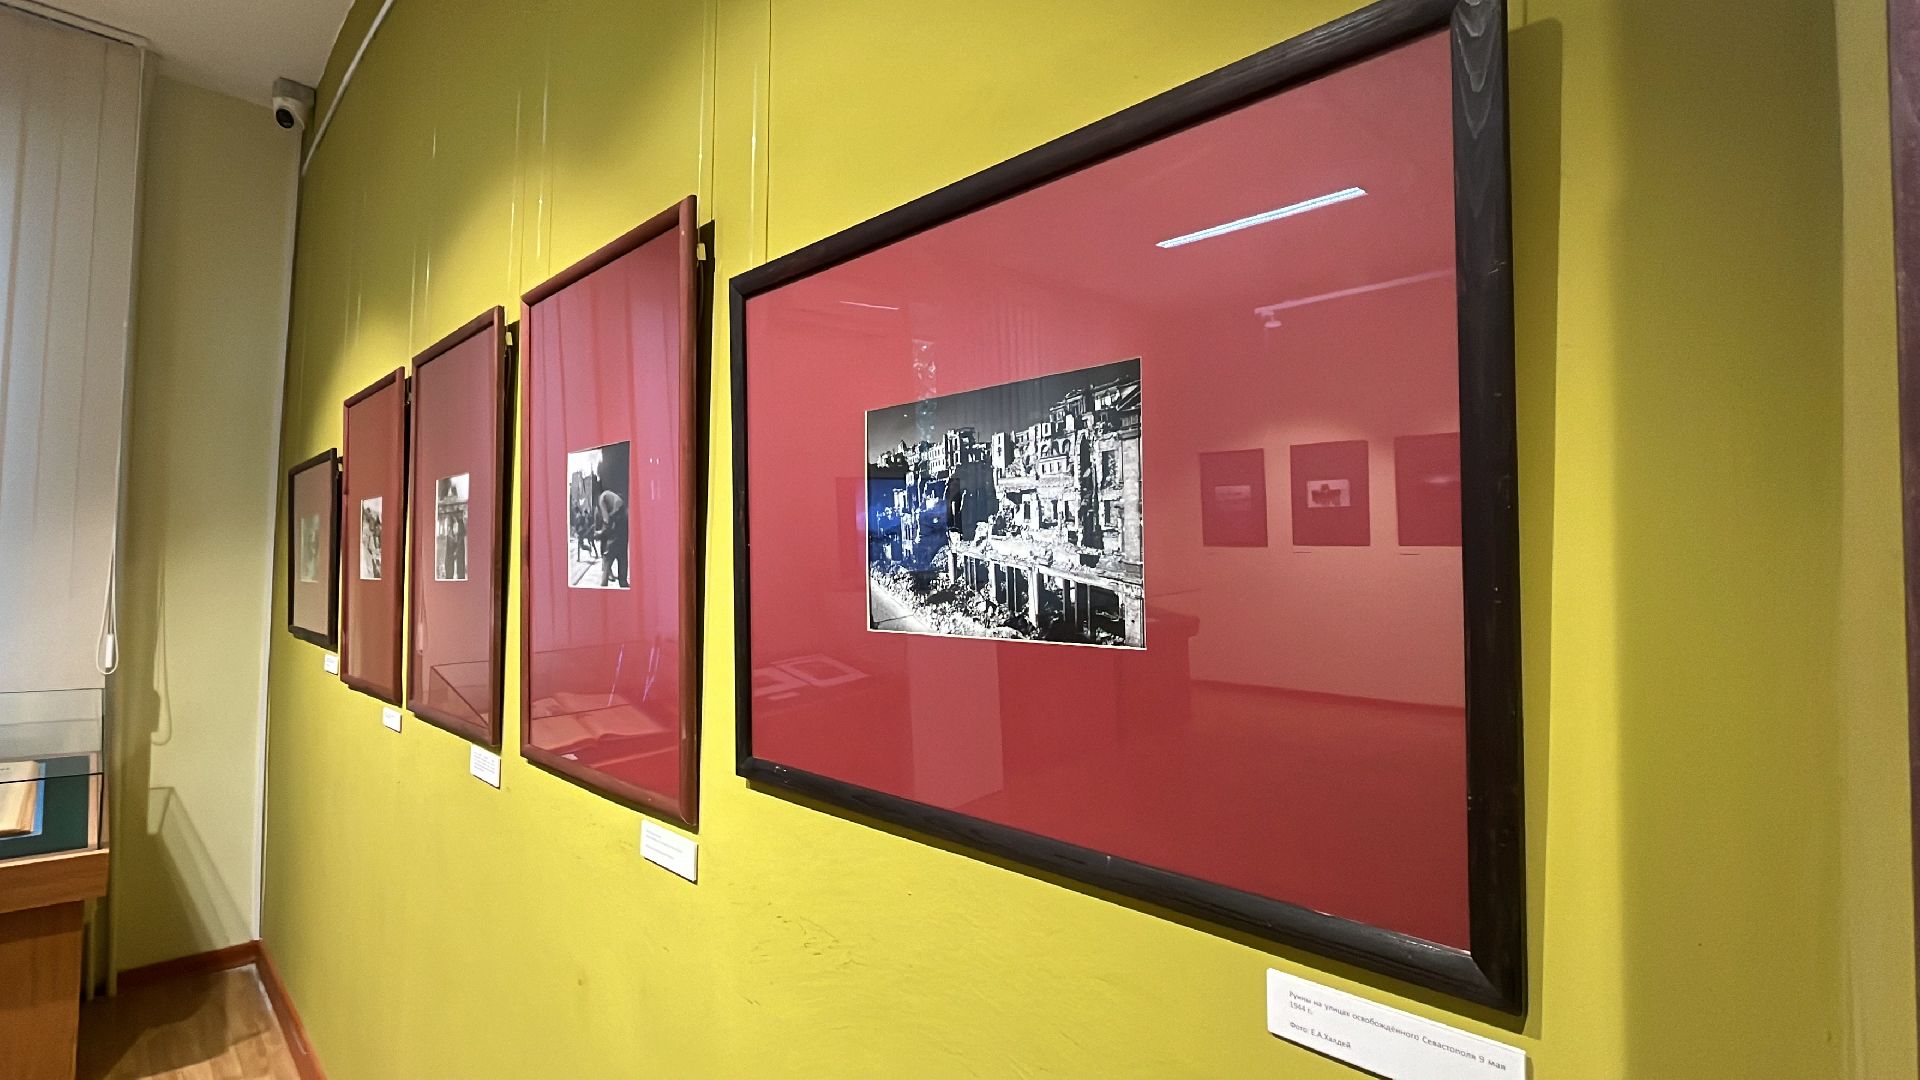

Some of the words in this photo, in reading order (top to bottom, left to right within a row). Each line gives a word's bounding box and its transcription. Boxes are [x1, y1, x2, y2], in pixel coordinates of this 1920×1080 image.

[1289, 1001, 1306, 1012] 1944
[1289, 990, 1311, 1004] Руины
[1313, 1000, 1322, 1008] на
[1324, 1003, 1350, 1017] улицах
[1422, 1035, 1477, 1060] Севастополя
[1478, 1055, 1485, 1063] 9
[1488, 1059, 1506, 1071] мая
